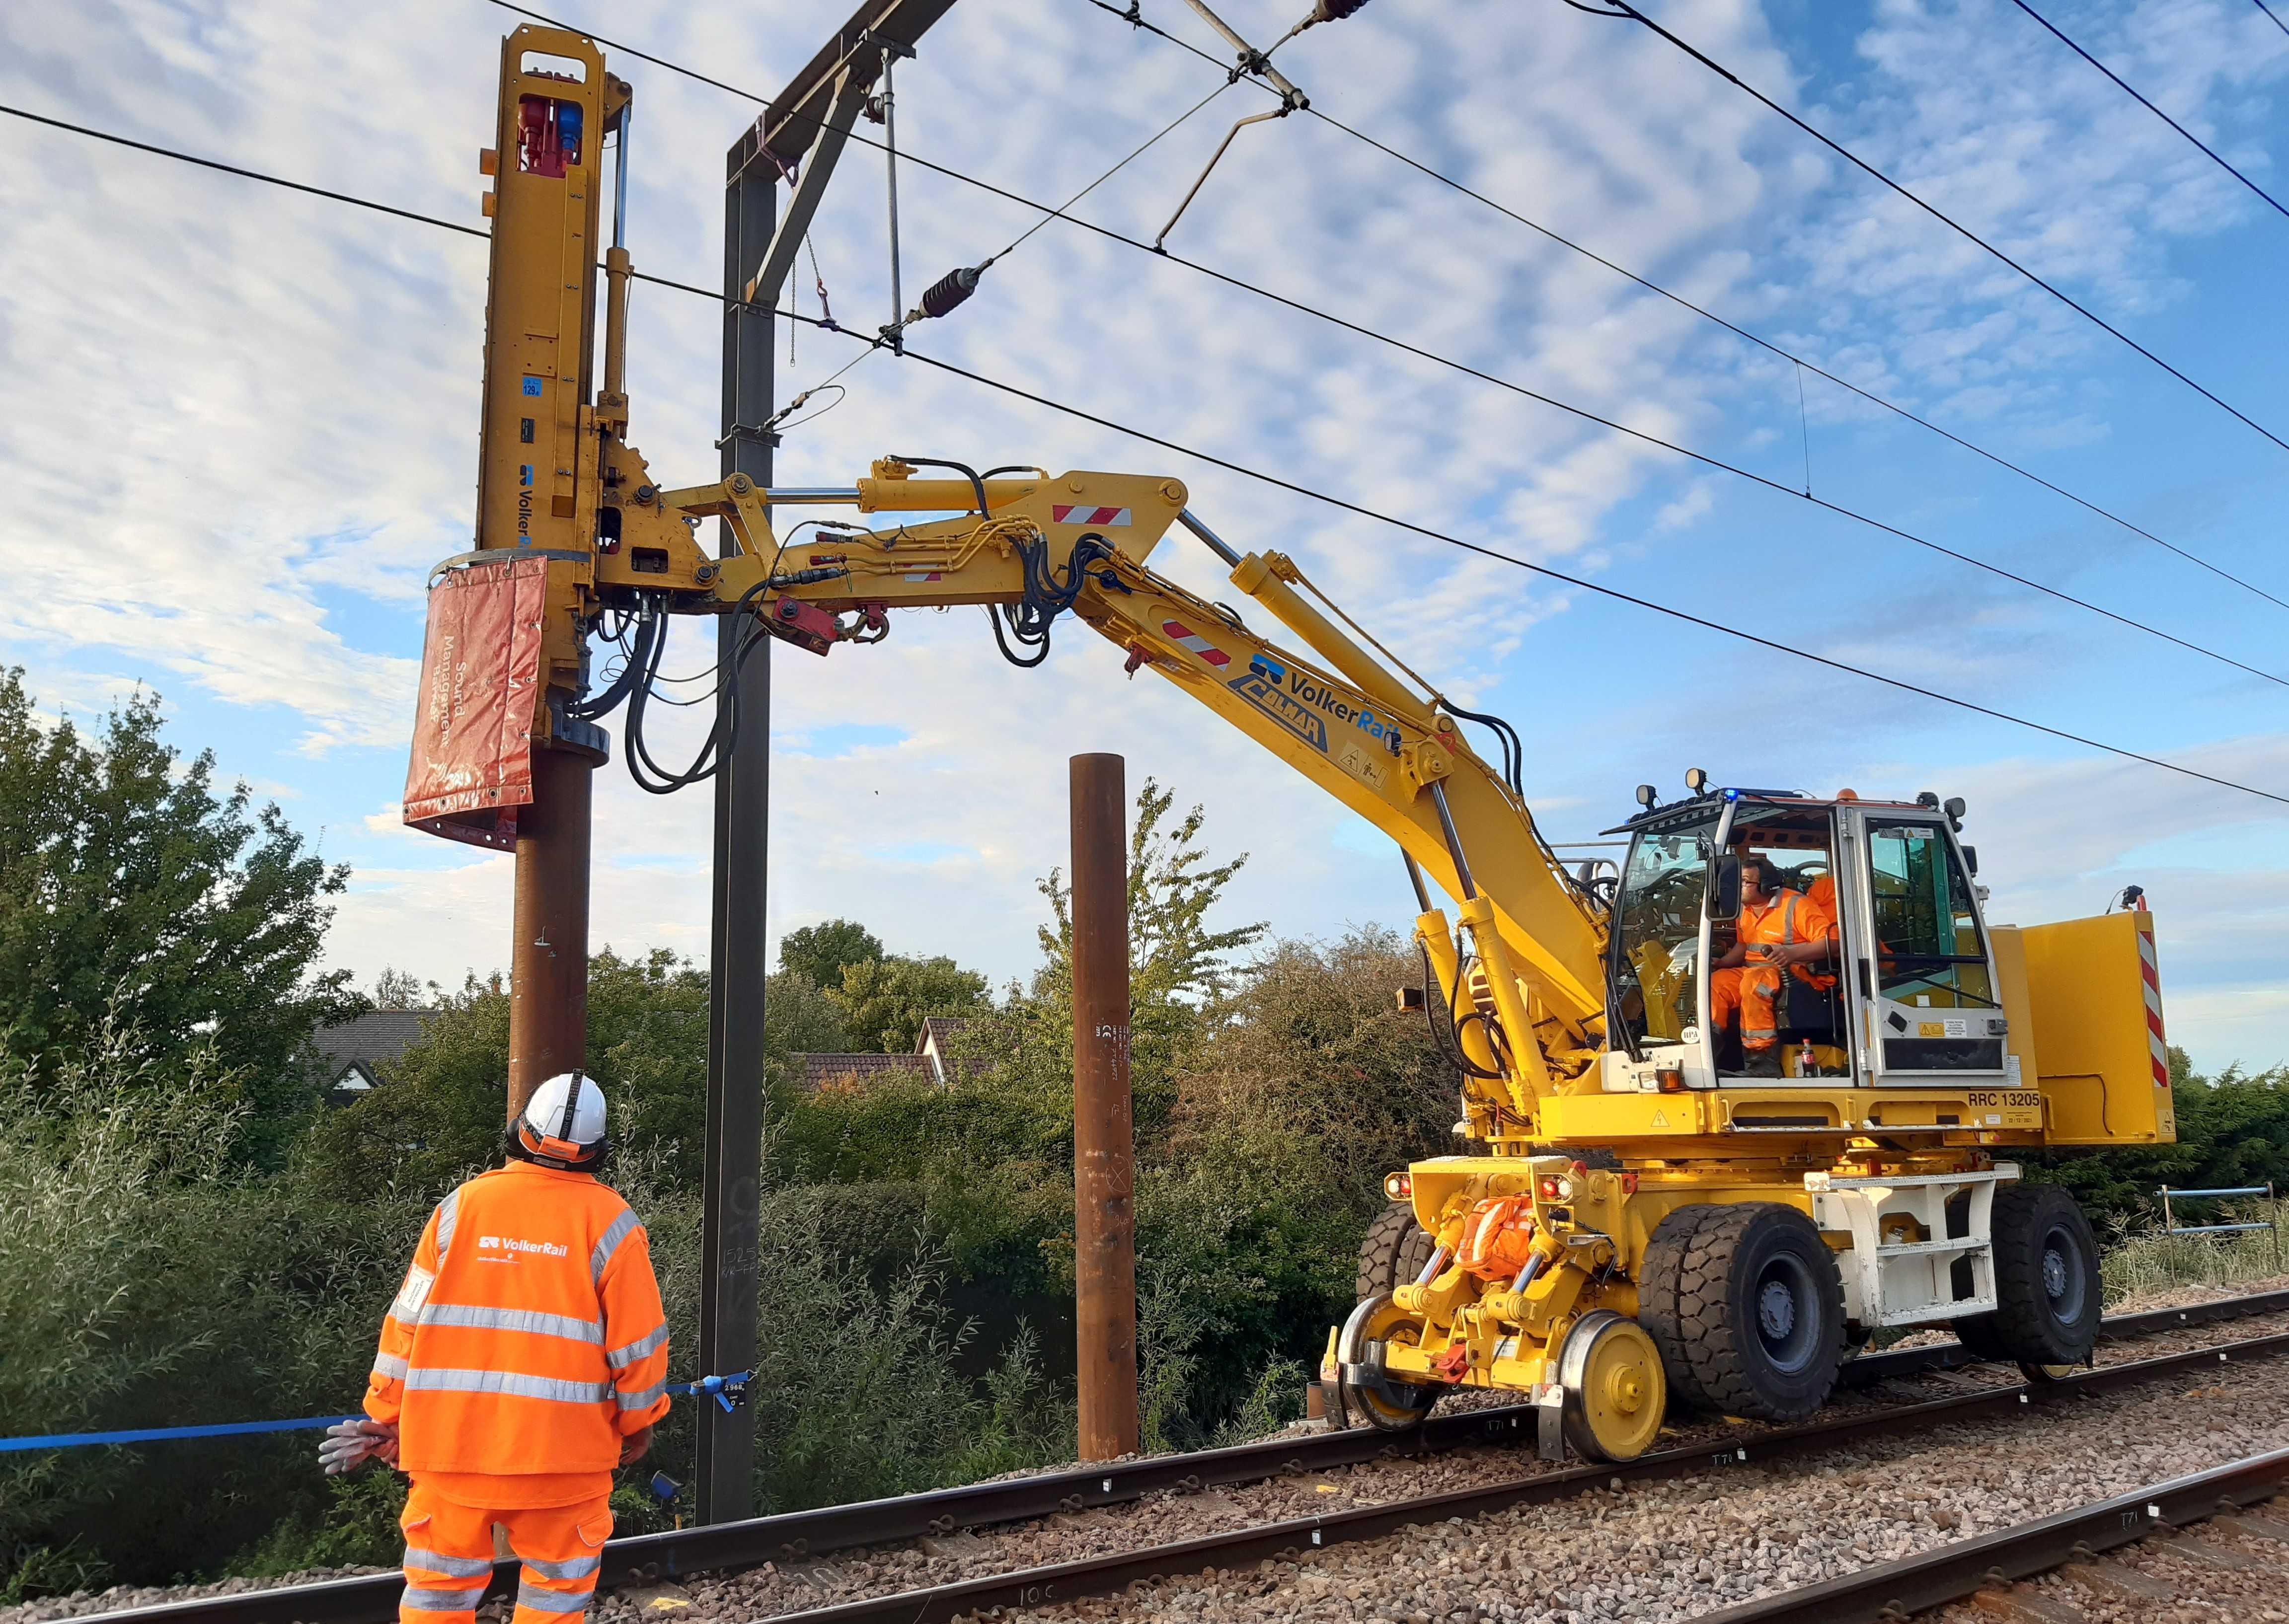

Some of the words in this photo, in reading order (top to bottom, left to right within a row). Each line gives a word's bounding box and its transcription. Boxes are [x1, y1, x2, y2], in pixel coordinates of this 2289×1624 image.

[439, 635, 455, 748] Management
[454, 661, 467, 718] Sound
[1240, 677, 1320, 743] CALMAR
[1969, 1093, 1997, 1107] RRC
[2001, 1093, 2040, 1107] 13205
[502, 1237, 568, 1257] VolkerRail
[723, 1247, 757, 1264] 1525
[409, 1279, 425, 1310] CONTROLLER
